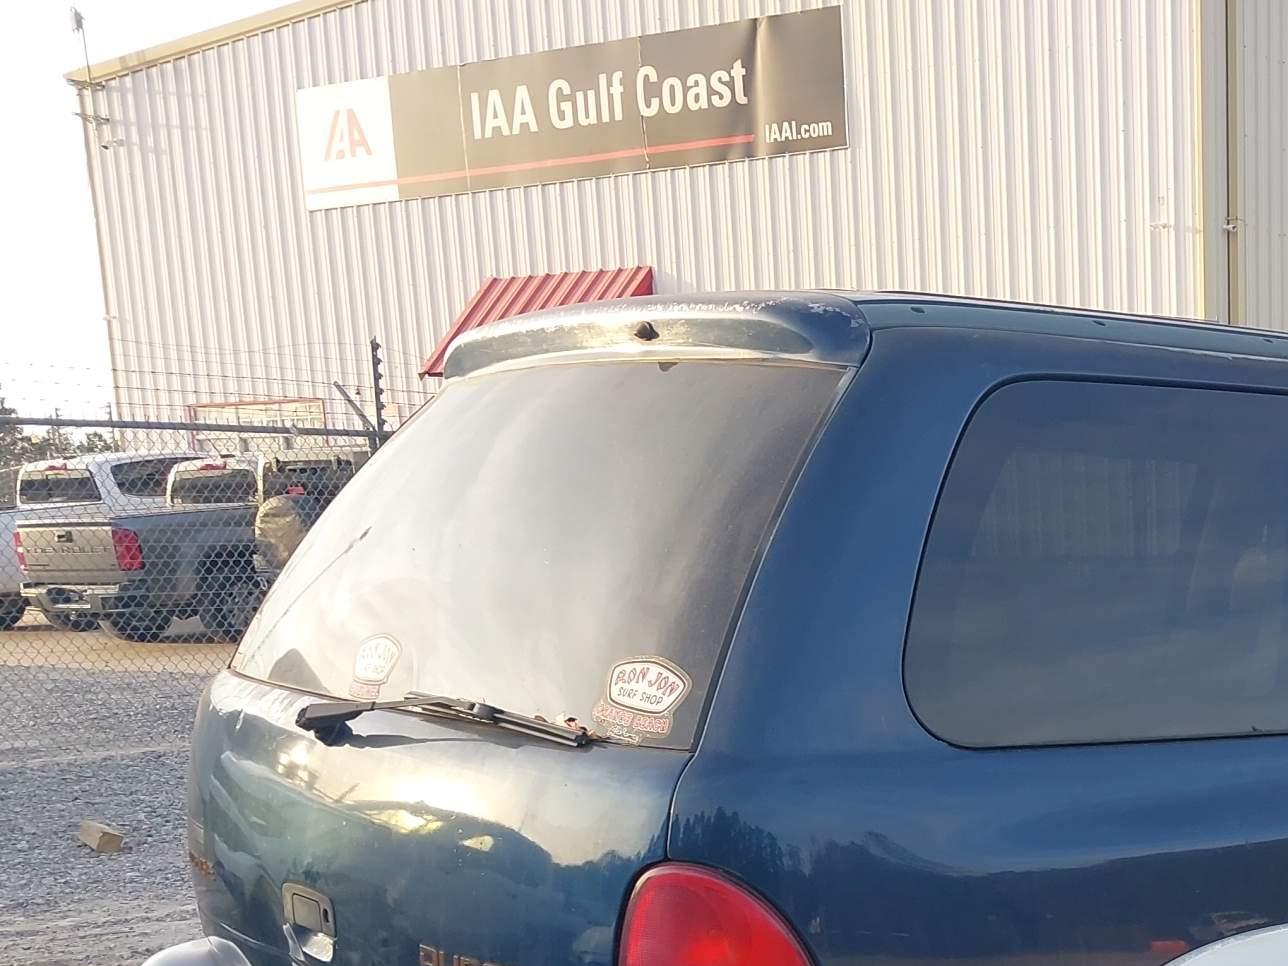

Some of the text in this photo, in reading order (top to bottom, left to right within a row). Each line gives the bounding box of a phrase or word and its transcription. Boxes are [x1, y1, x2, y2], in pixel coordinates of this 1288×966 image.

[471, 58, 749, 140] IAA Gulf Coast
[764, 118, 834, 144] IAAI.com
[614, 666, 681, 698] RON JON
[617, 686, 664, 706] SURF SHOP
